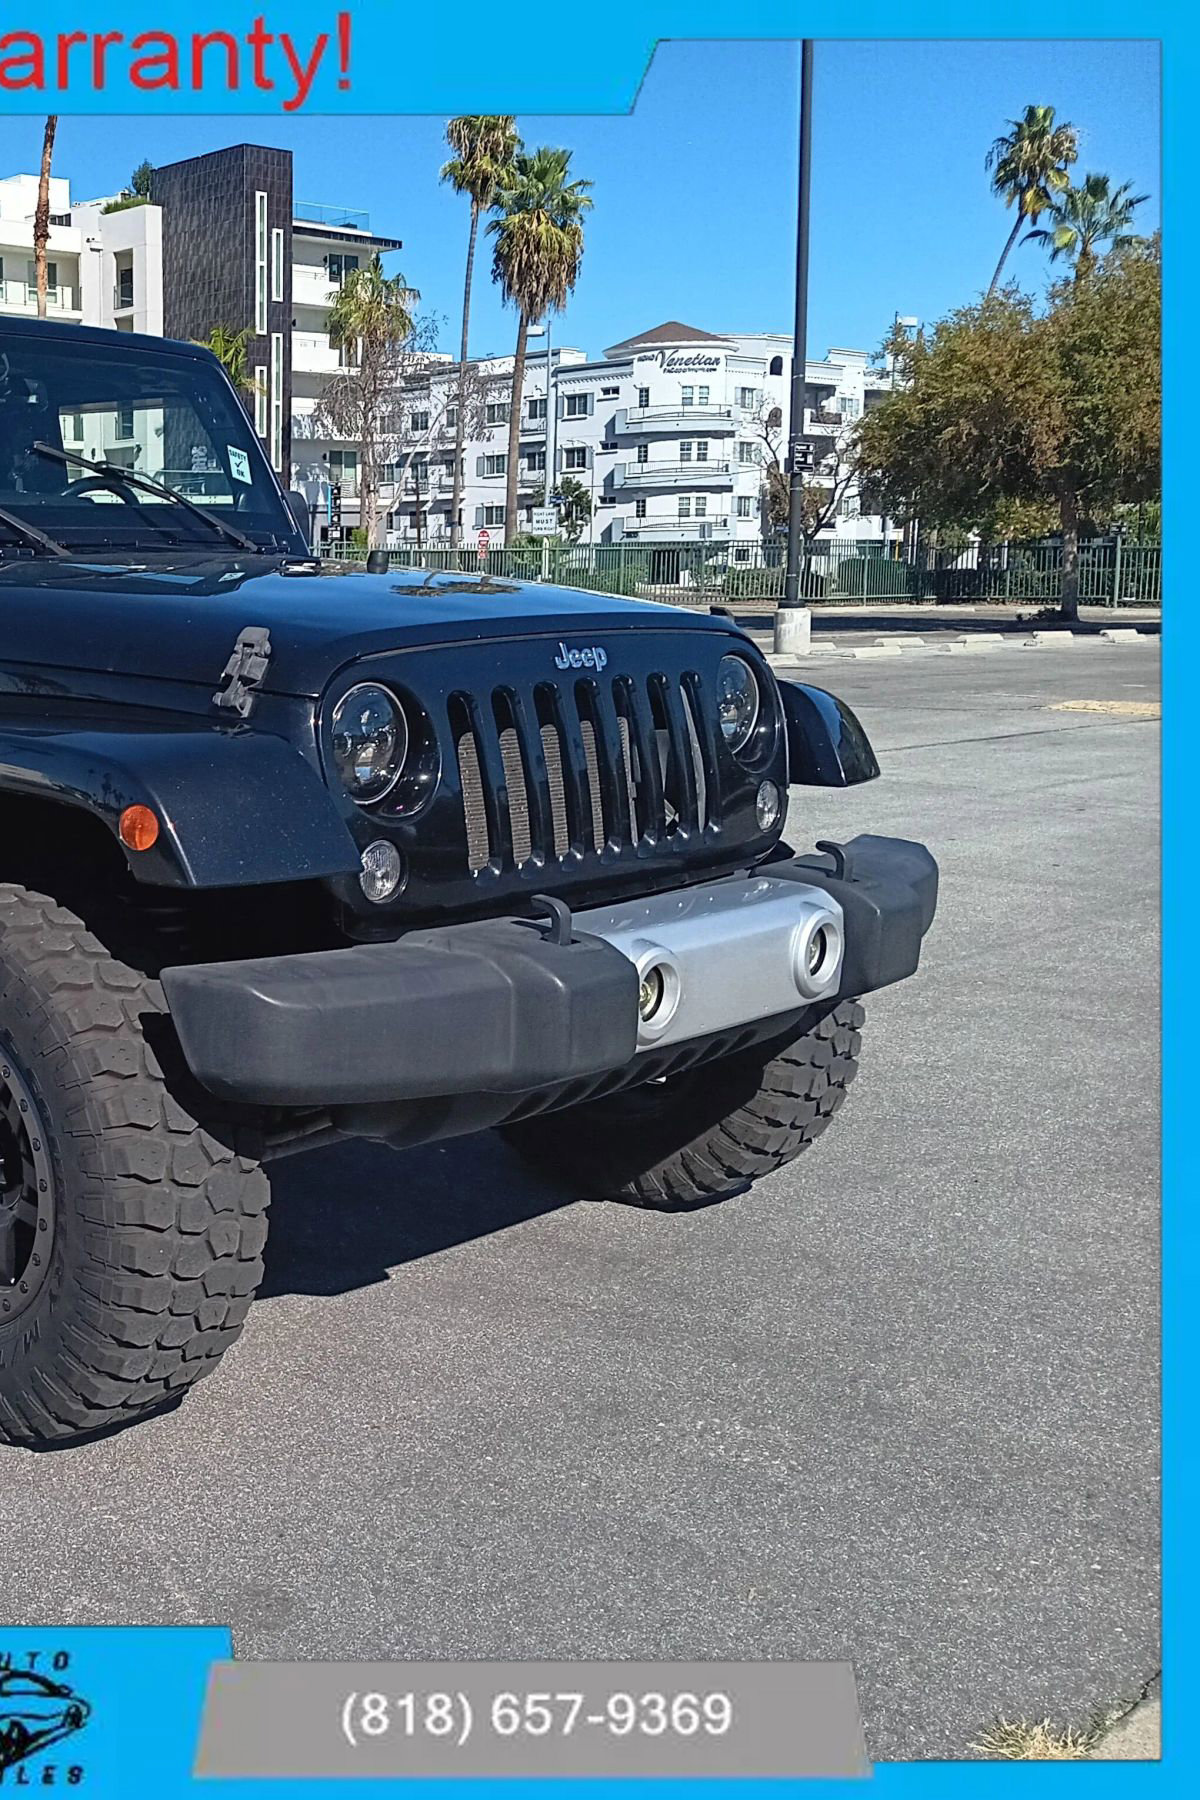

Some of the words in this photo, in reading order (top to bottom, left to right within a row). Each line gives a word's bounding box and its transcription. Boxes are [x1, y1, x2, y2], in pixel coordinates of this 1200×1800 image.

[655, 349, 720, 368] Venetian
[236, 468, 246, 478] OK
[554, 642, 608, 672] Jeep
